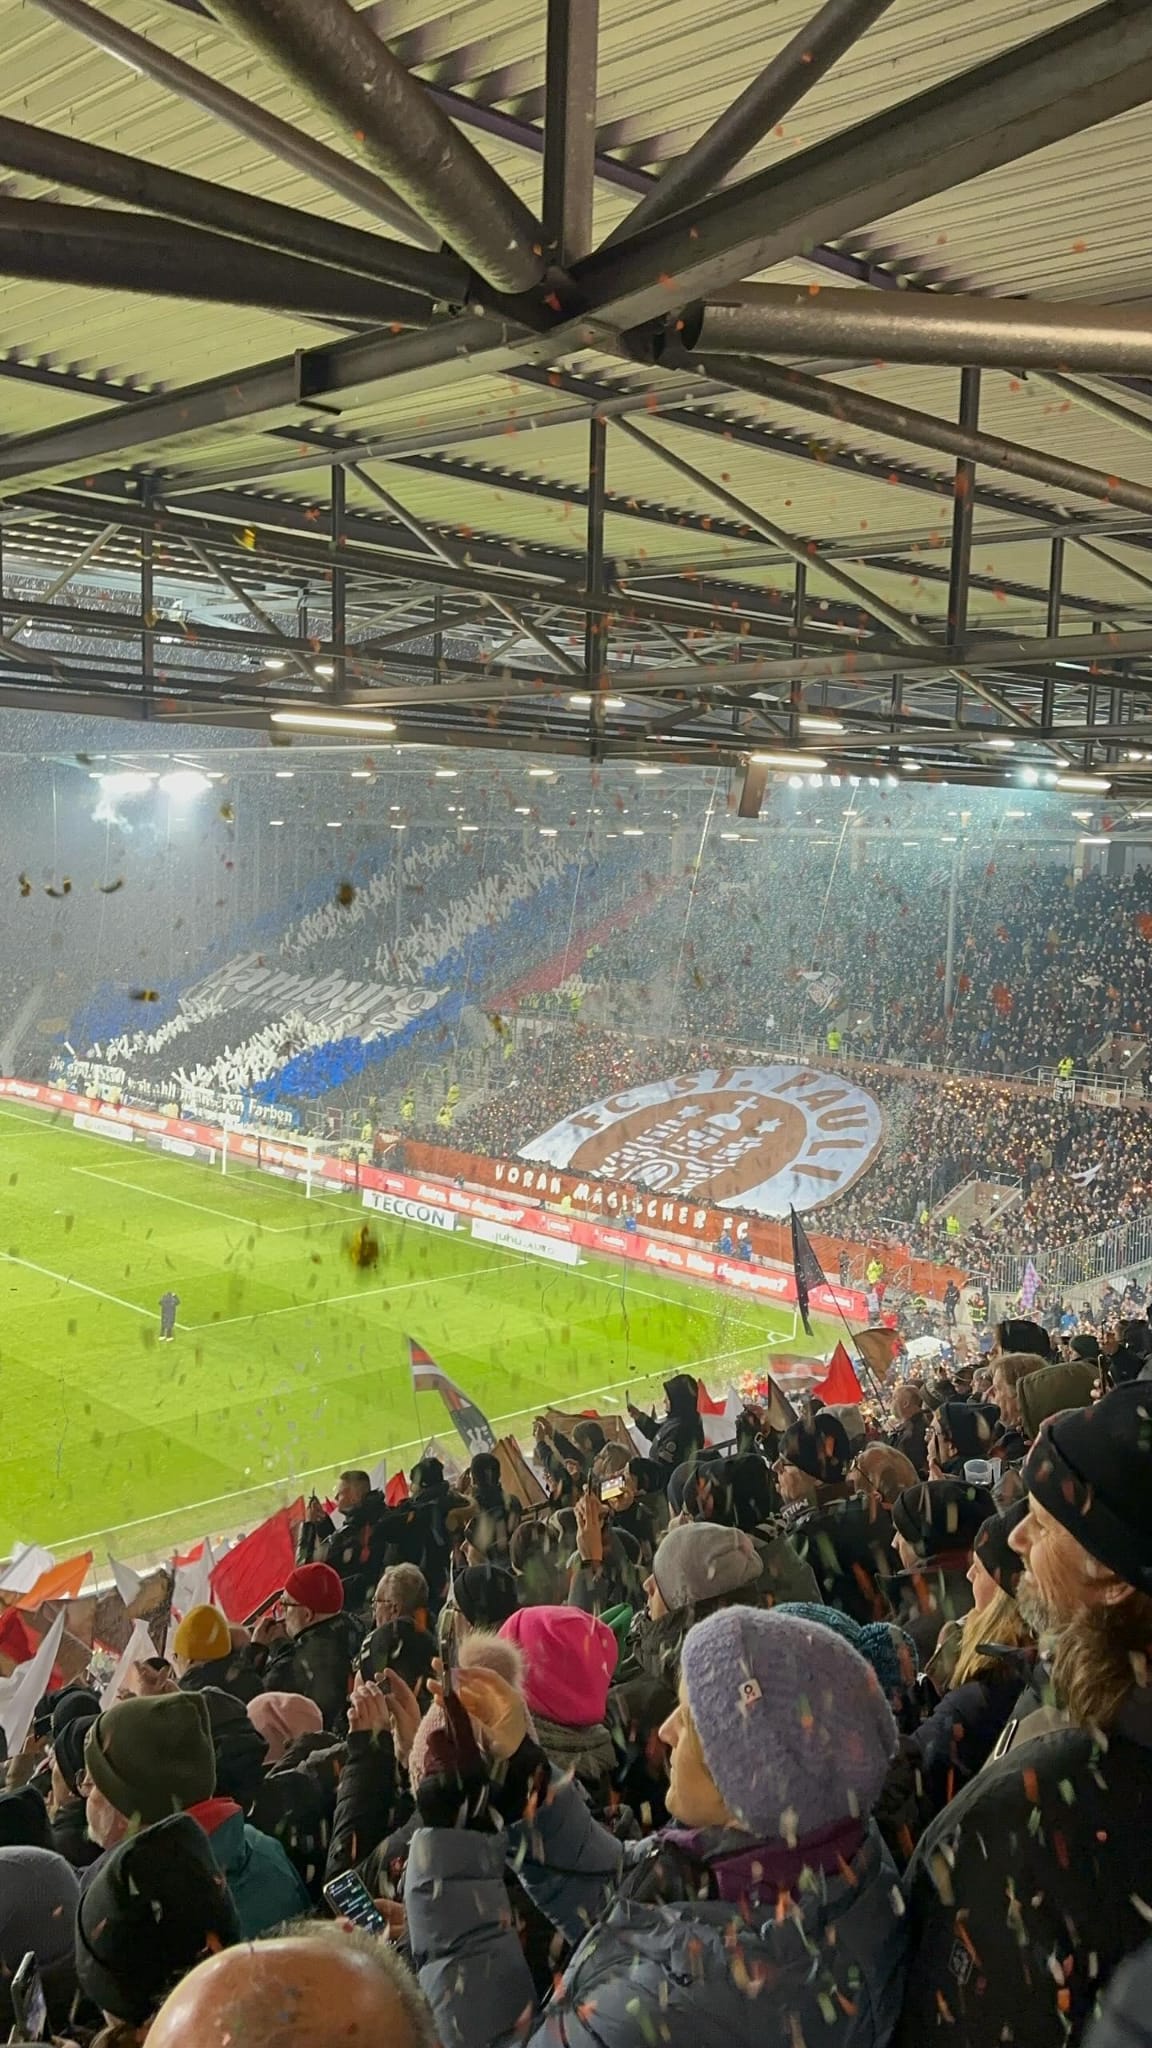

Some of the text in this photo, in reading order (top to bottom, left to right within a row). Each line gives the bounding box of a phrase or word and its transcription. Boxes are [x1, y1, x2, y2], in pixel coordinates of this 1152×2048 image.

[249, 1098, 293, 1123] Farben
[567, 1067, 869, 1182] FC ST. PAULI
[494, 1164, 561, 1194] VORAN
[371, 1193, 445, 1227] TECCON
